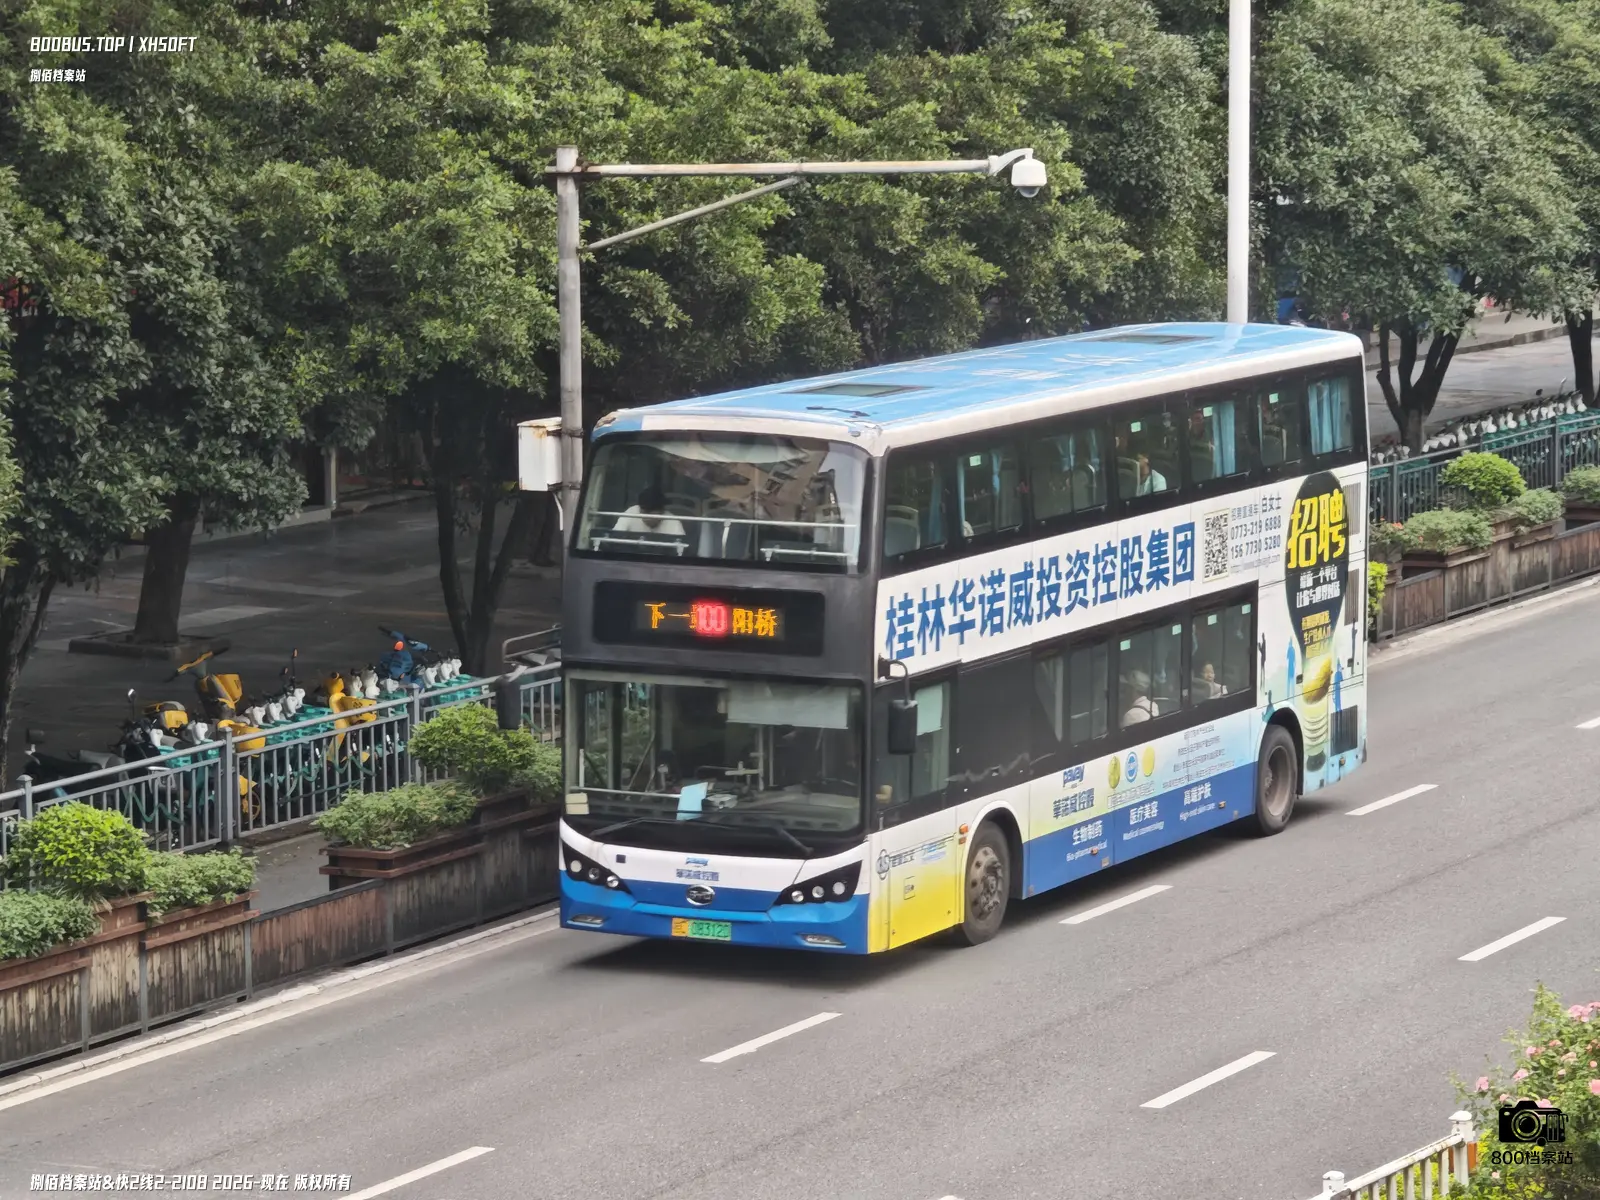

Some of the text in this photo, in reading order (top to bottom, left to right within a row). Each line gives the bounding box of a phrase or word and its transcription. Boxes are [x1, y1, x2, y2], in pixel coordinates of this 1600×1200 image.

[1287, 488, 1346, 569] 招聘
[885, 522, 1195, 660] 桂林华诺威投资控股集团
